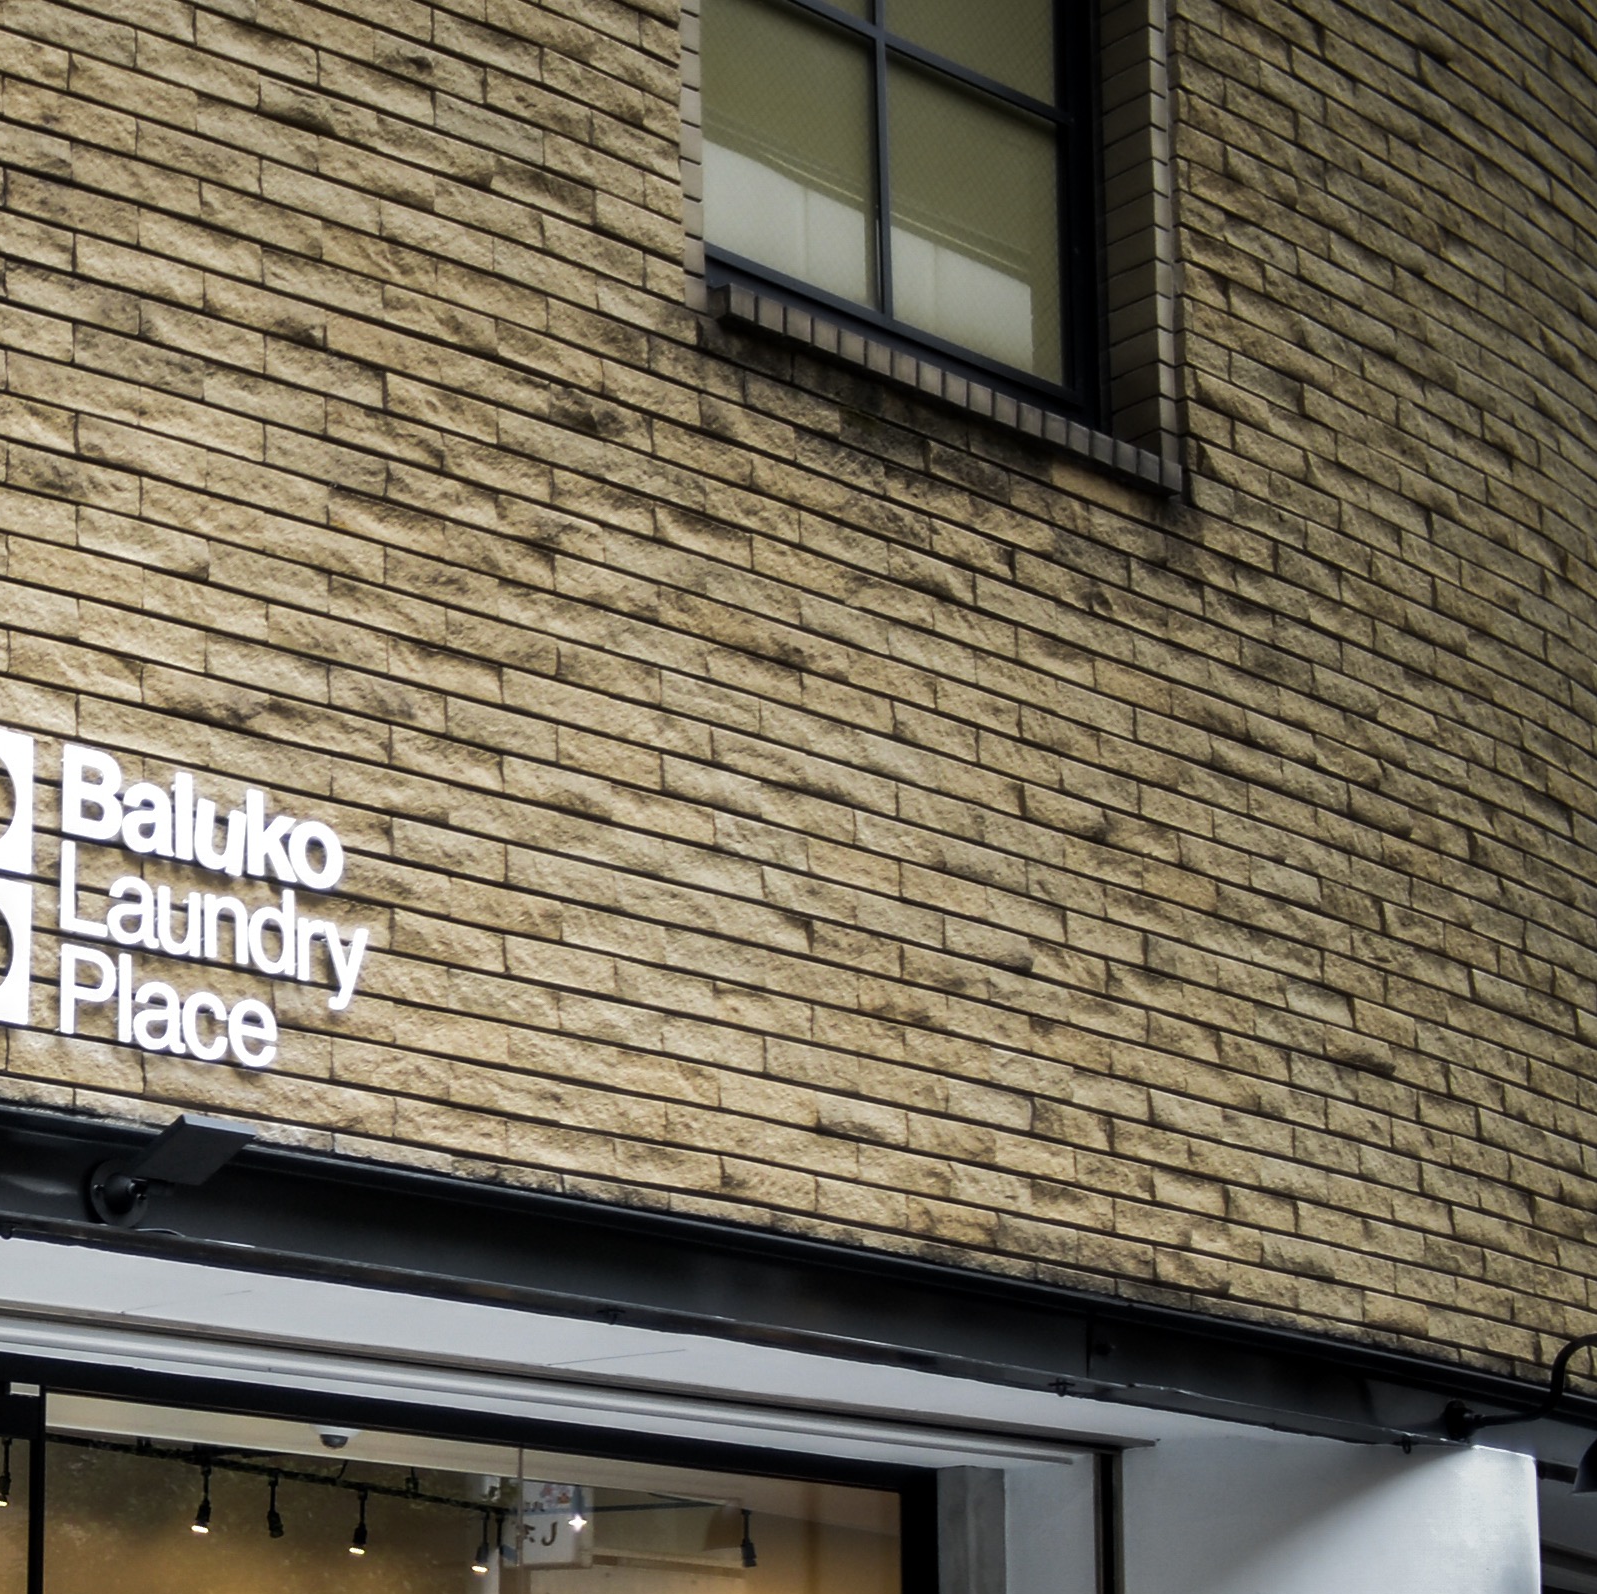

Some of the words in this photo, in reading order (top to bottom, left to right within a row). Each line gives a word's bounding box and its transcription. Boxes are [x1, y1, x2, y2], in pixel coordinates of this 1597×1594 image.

[61, 744, 344, 890] Baluko
[60, 841, 369, 1010] Laundry
[60, 943, 278, 1067] Place
